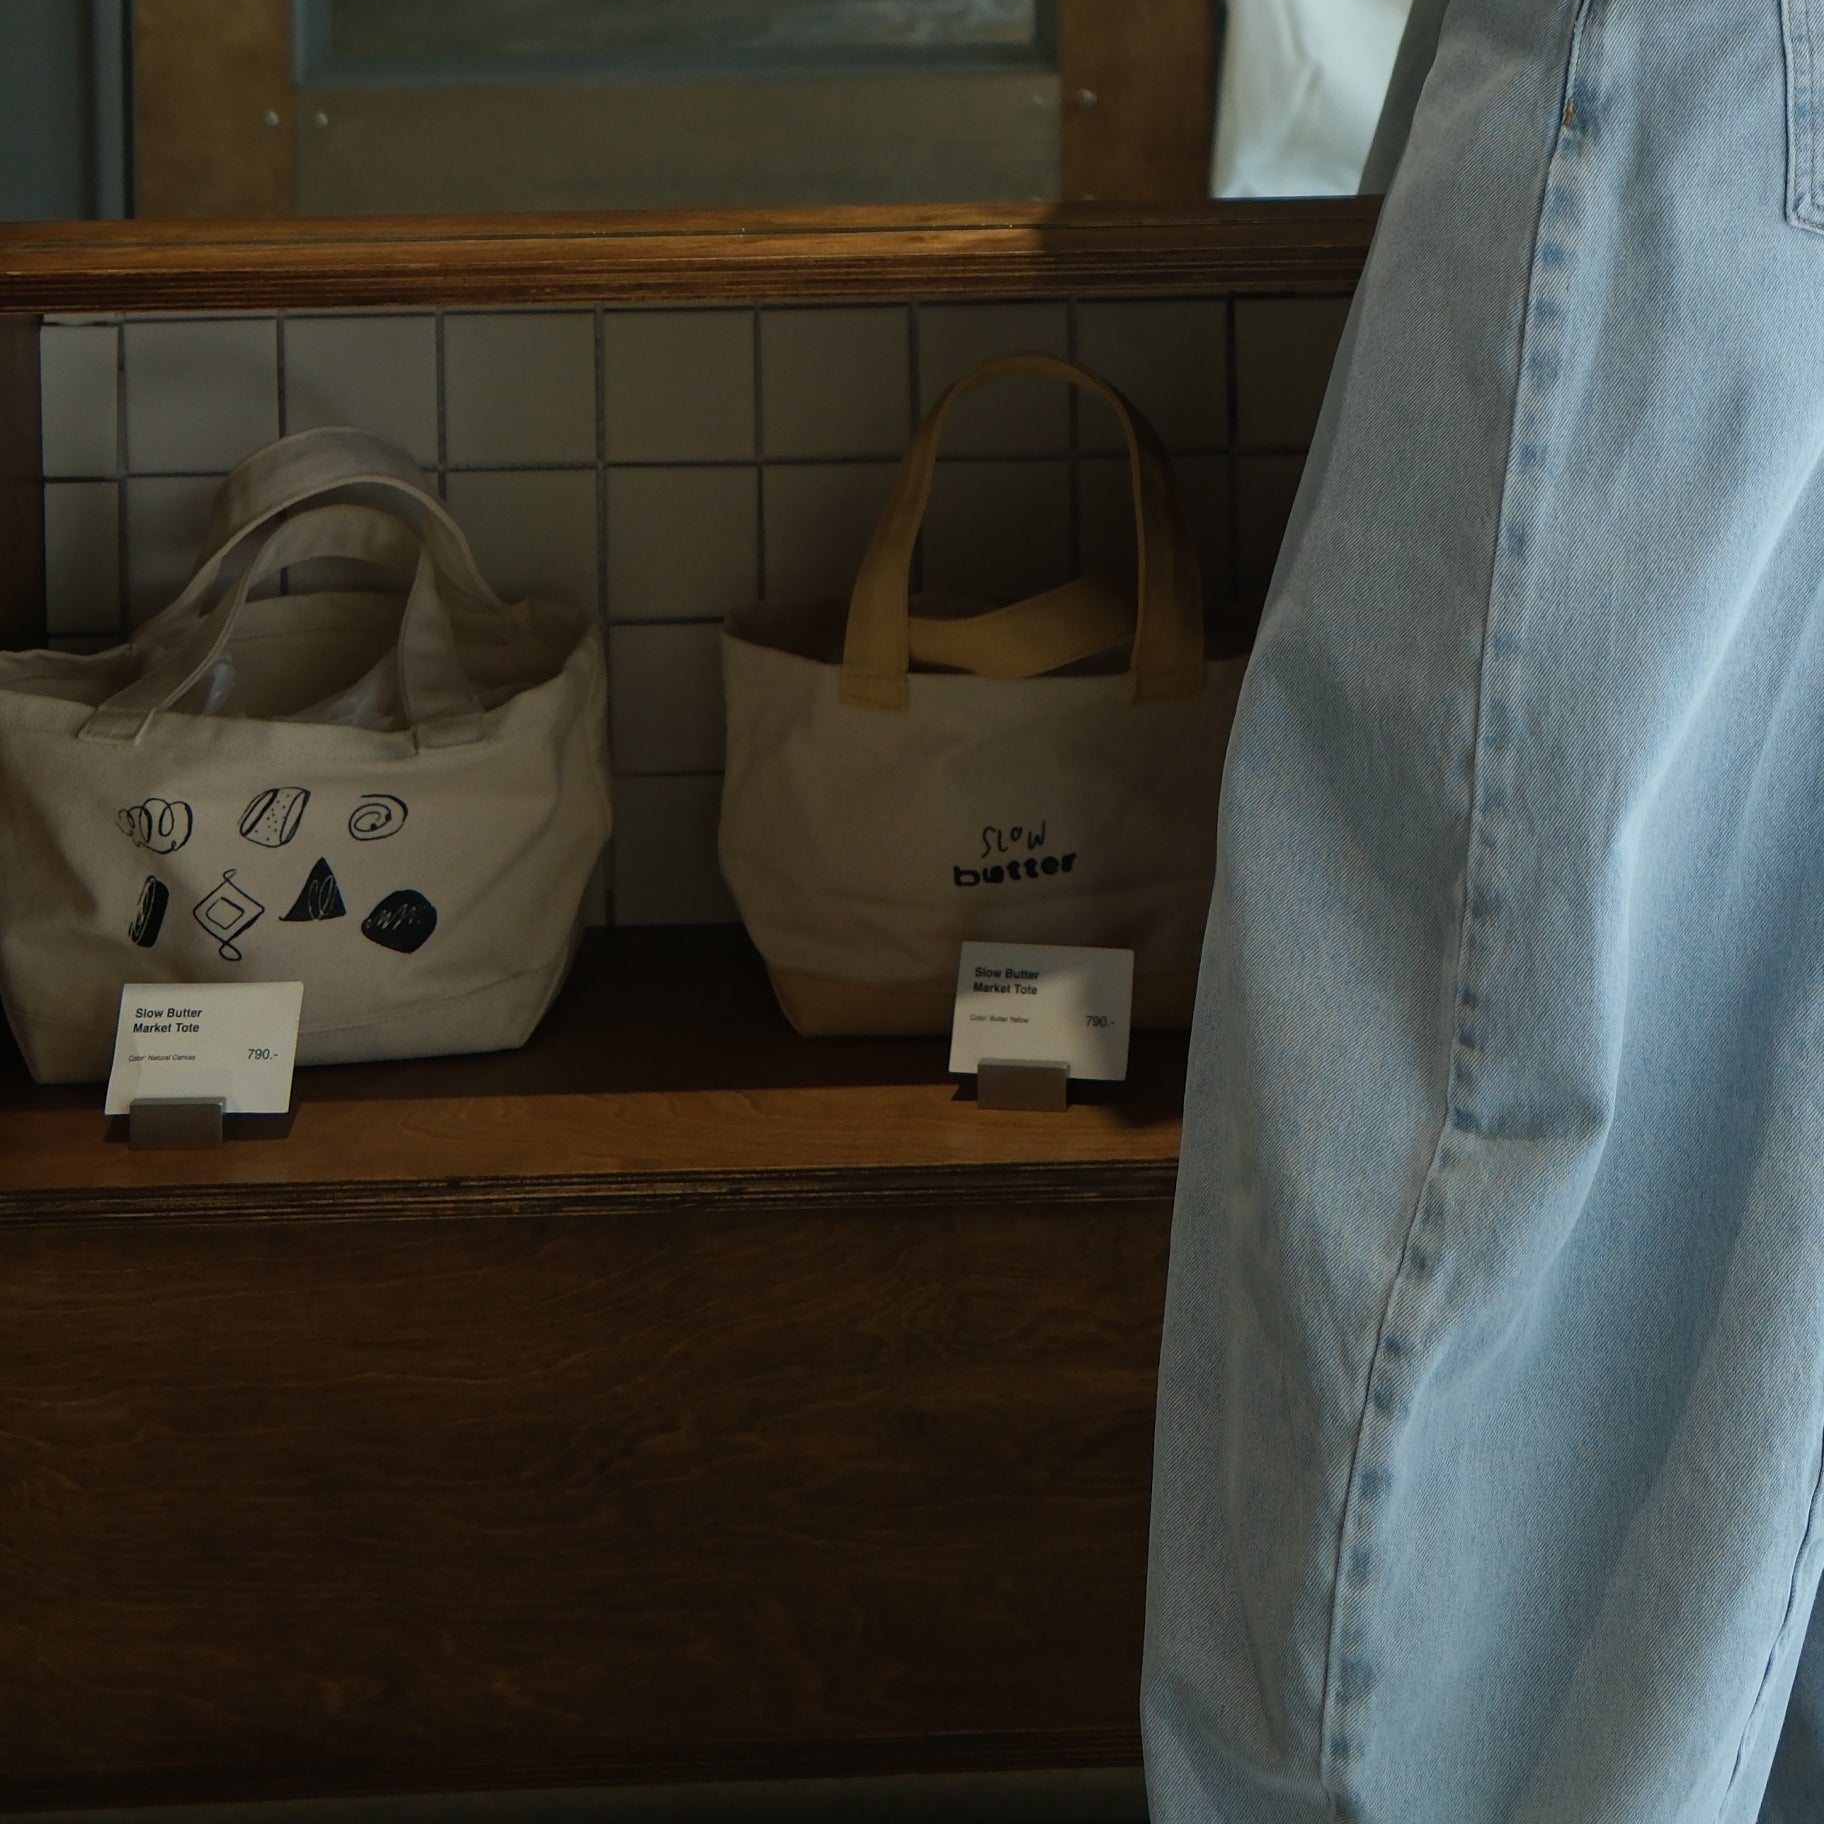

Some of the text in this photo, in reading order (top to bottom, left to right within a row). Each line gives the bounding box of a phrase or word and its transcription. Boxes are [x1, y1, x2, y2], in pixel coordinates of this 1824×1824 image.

[953, 852, 1077, 886] butter
[974, 966, 1040, 981] Slow Butter
[972, 982, 1038, 996] Market Tote
[135, 1007, 203, 1019] Slow Butter
[132, 1022, 200, 1033] Market Tote
[248, 1048, 278, 1061] 790.-
